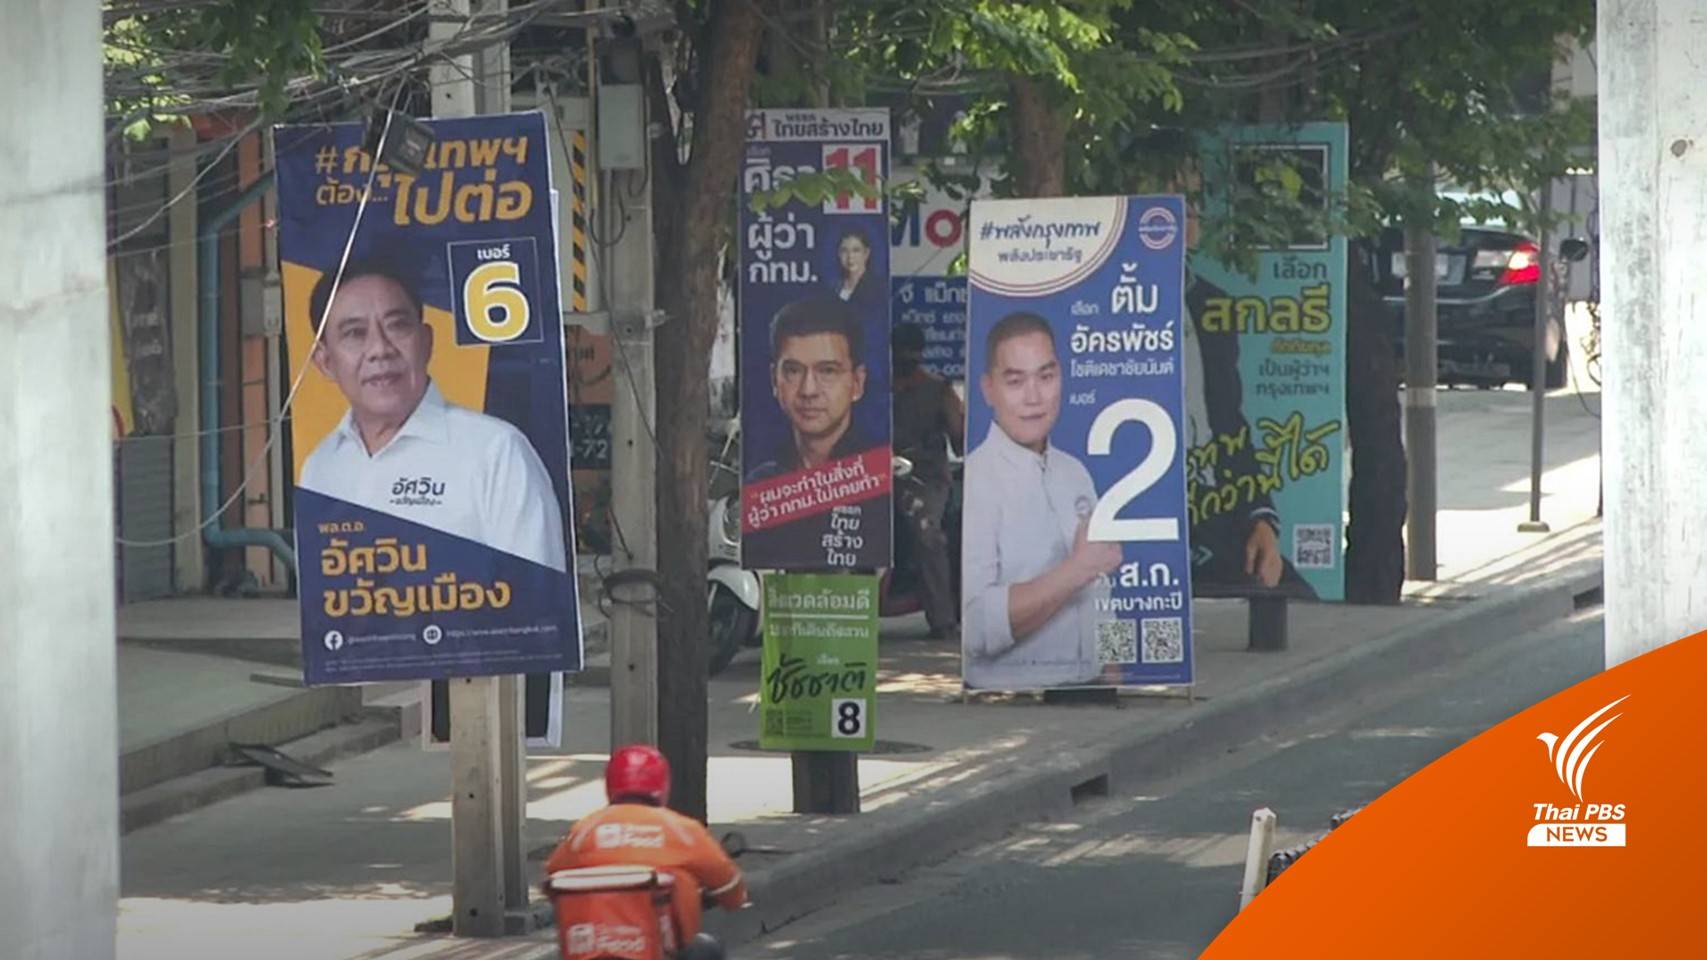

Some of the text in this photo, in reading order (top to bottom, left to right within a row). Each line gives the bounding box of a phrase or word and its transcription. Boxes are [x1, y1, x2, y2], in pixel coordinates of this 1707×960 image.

[773, 118, 884, 139] ไทยสร้างไทย
[393, 169, 533, 225] ไปต่อ
[748, 212, 815, 261] ผู้ว่า
[980, 215, 1102, 249] #พลังกรุงเทพ
[477, 243, 511, 260] เบอร์
[1274, 256, 1328, 280] เลือก
[749, 261, 818, 283] กทม.
[1111, 262, 1159, 314] ตั้ม
[463, 261, 531, 343] 6
[1200, 283, 1331, 334] สกลธี
[1070, 321, 1174, 353] อัครพัชร์
[392, 477, 446, 496] อัศวิน
[1087, 398, 1180, 541] 2
[831, 513, 860, 530] ไทย
[821, 529, 863, 549] สร้าง
[321, 538, 427, 576] อัศวิน
[827, 549, 857, 566] ไทย
[1120, 561, 1179, 587] ส.ก.
[324, 572, 512, 617] ขวัญเมือง
[767, 653, 867, 704] ชัชชาติ
[838, 701, 860, 736] 8
